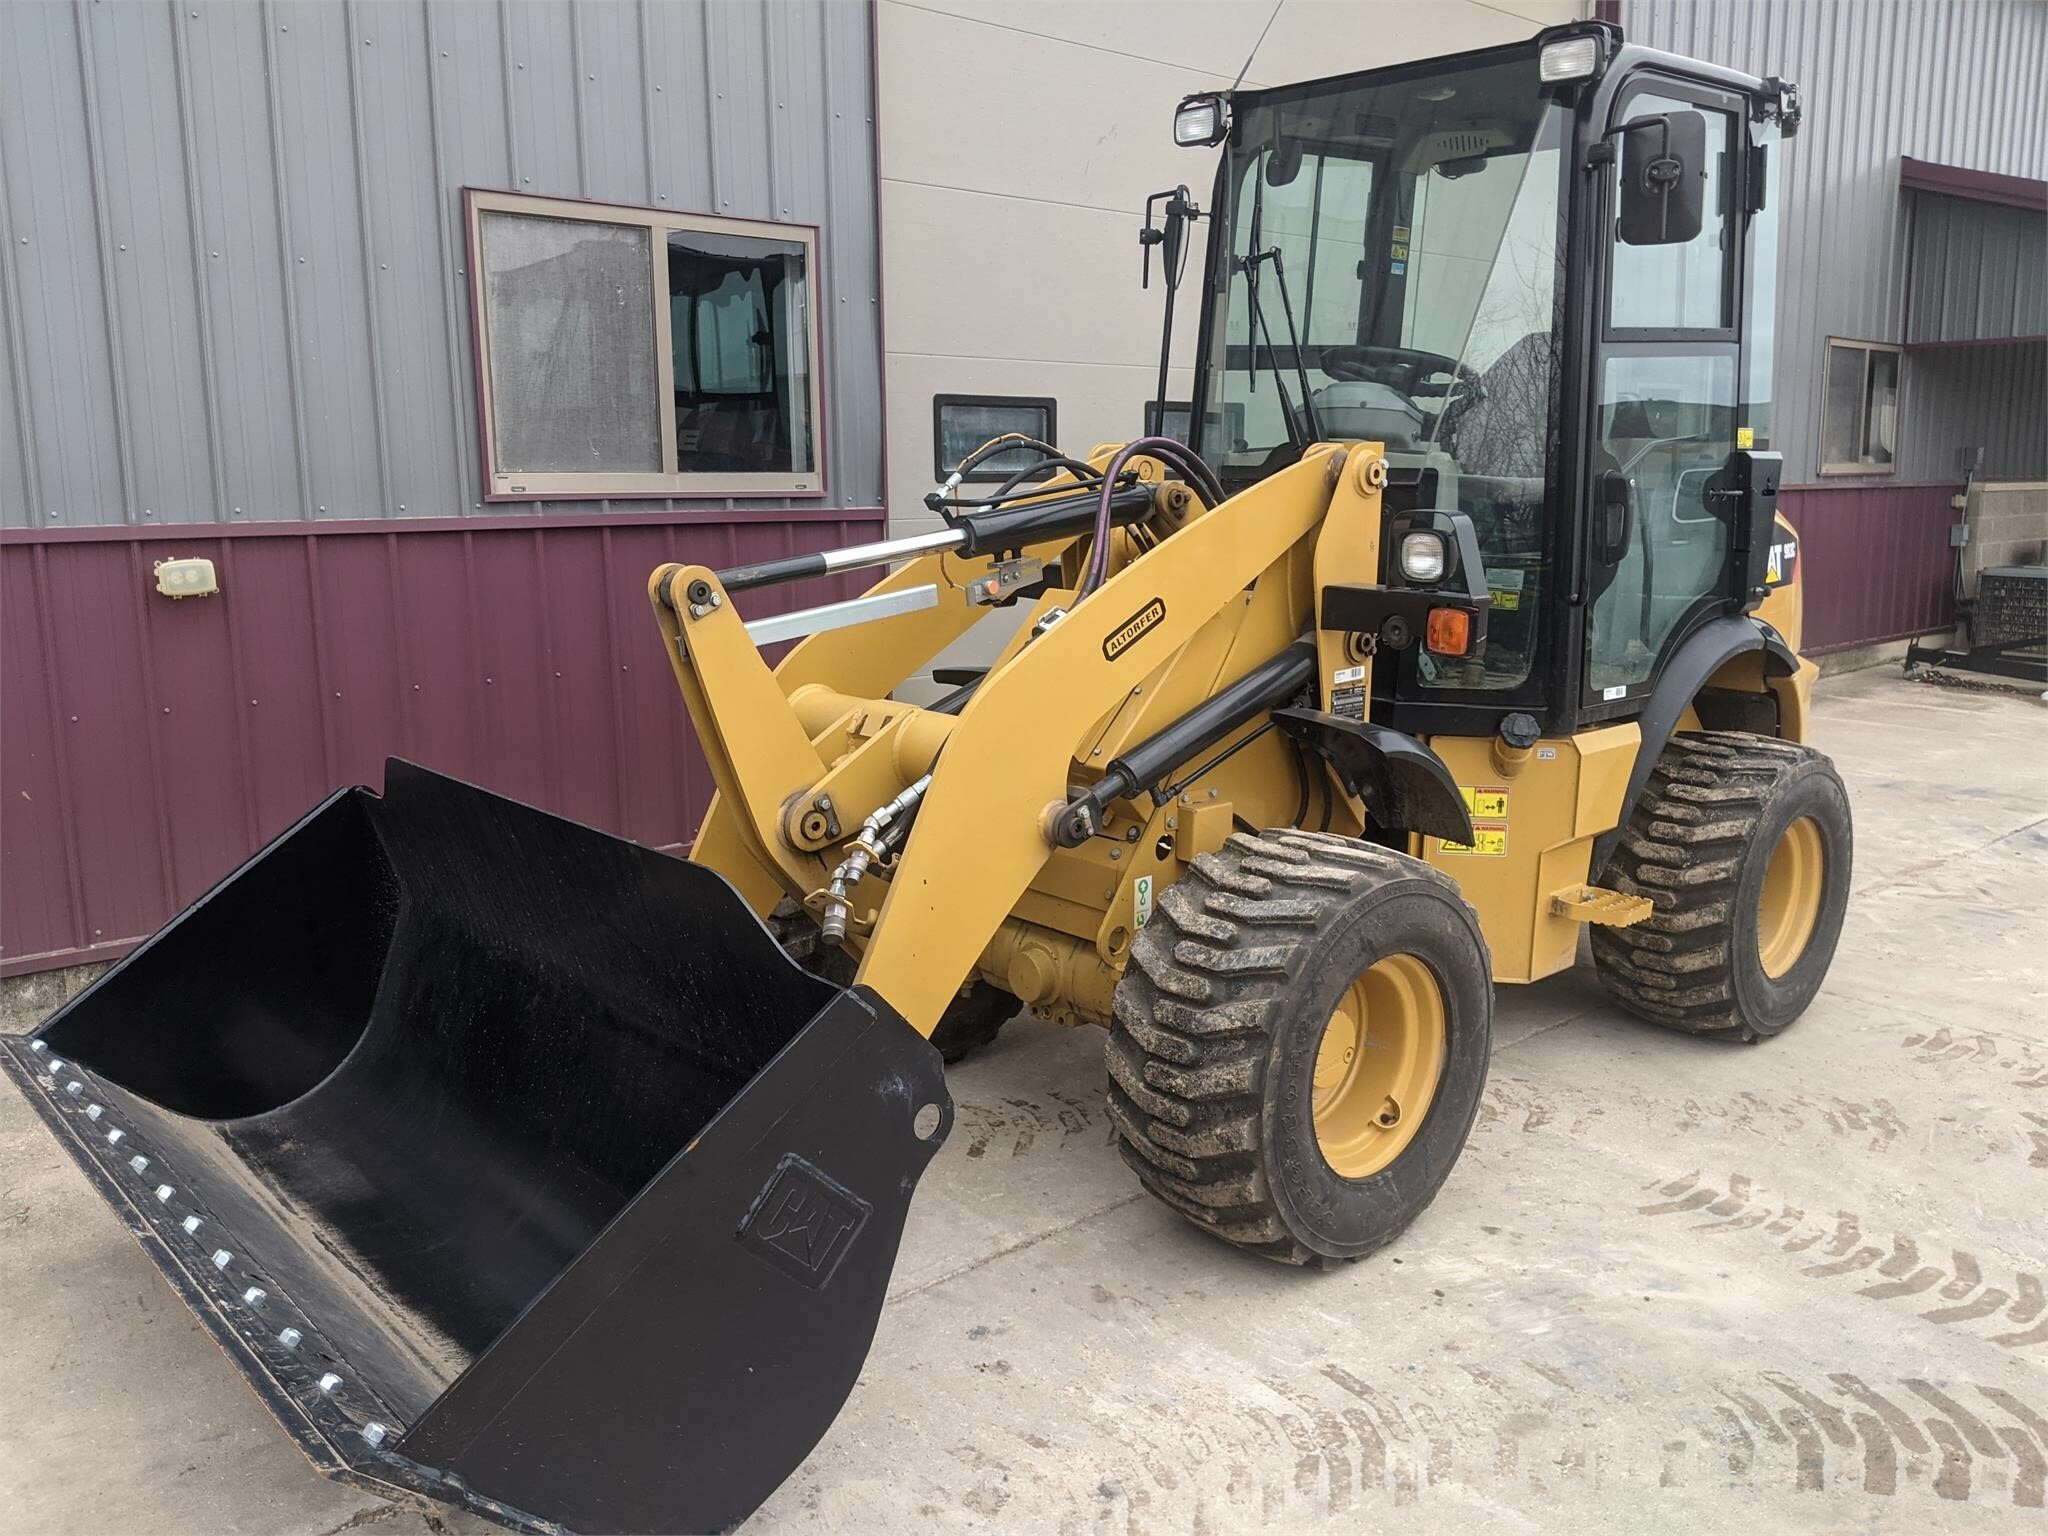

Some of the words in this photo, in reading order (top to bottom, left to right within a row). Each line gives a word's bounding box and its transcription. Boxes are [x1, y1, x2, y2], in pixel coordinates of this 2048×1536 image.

[1766, 544, 1782, 583] AT
[1111, 607, 1159, 651] ALTORFER
[757, 1184, 856, 1271] CAT
